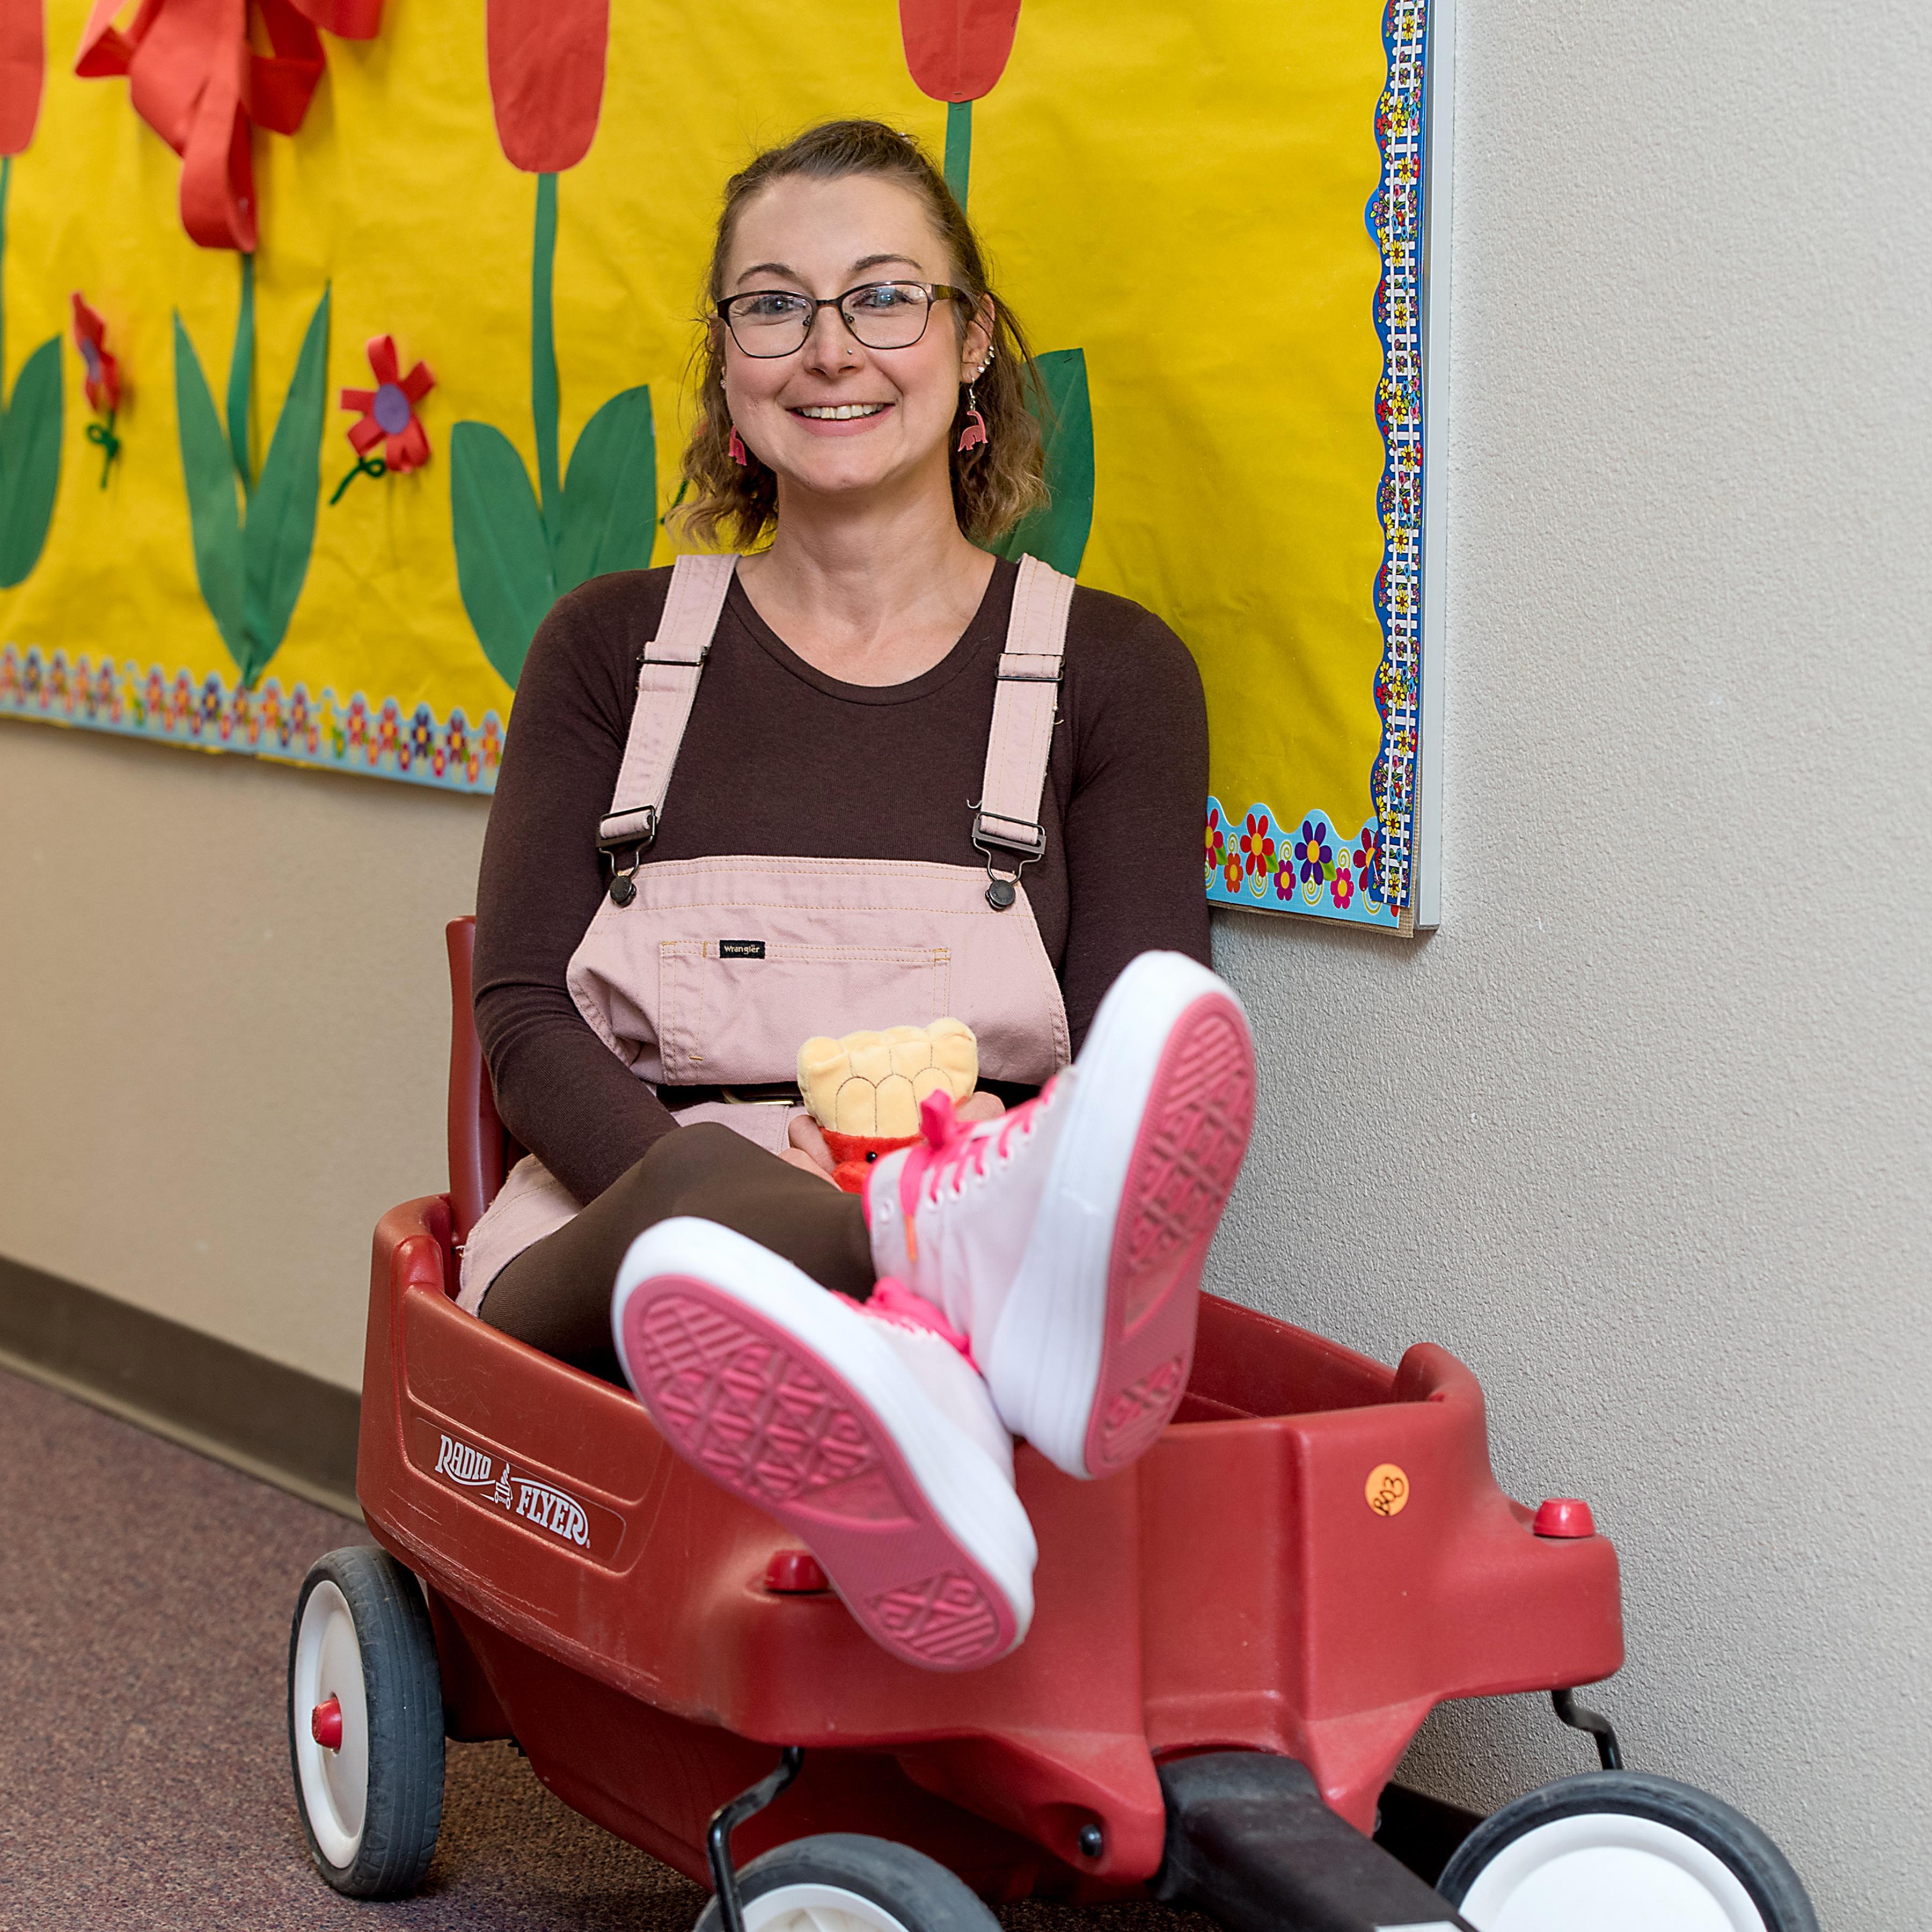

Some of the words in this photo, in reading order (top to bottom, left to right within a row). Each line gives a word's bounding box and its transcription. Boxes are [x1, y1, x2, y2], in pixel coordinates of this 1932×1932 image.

[723, 945, 760, 955] Wrangler
[435, 1435, 494, 1485] RADIO
[511, 1478, 589, 1546] FLYER
